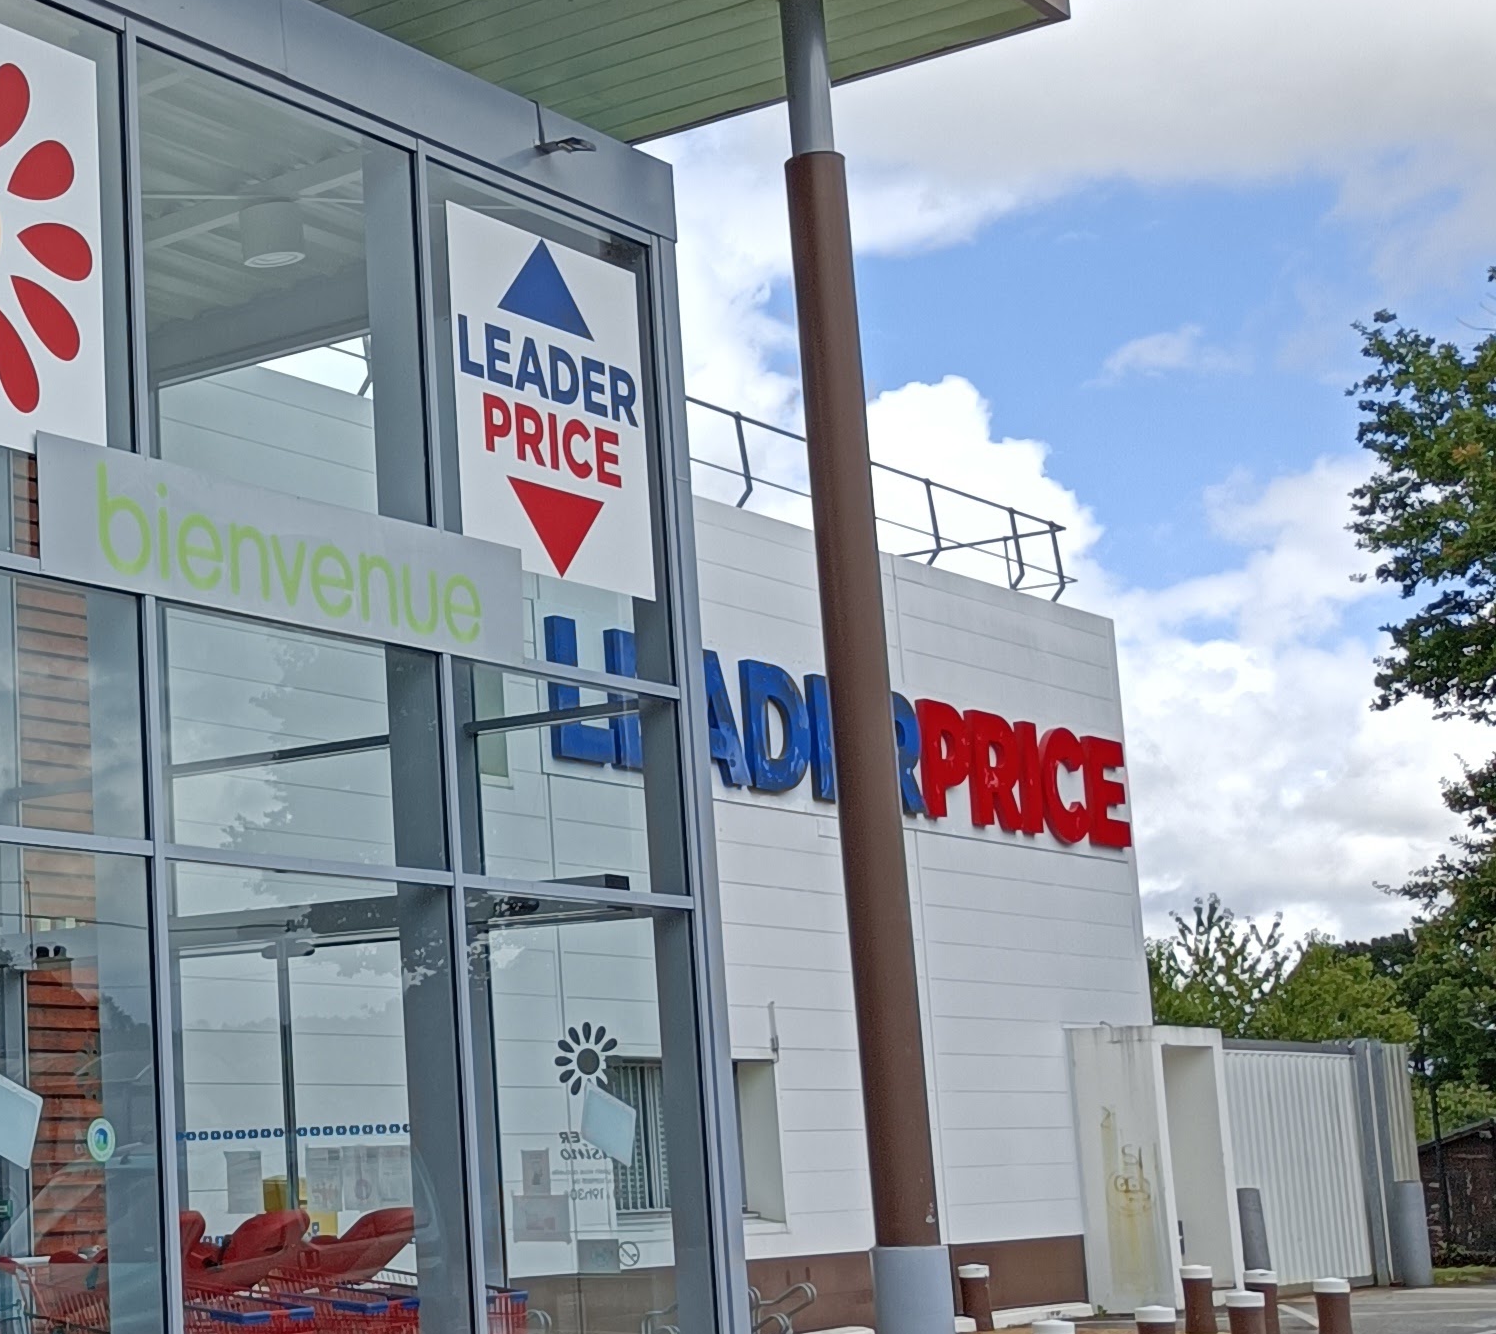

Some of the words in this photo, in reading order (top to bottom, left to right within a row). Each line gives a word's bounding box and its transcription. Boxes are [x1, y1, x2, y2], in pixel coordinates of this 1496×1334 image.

[458, 313, 638, 428] LEADER
[482, 392, 622, 489] PRICE
[97, 460, 481, 643] bienvenue
[915, 699, 1132, 848] PRICE
